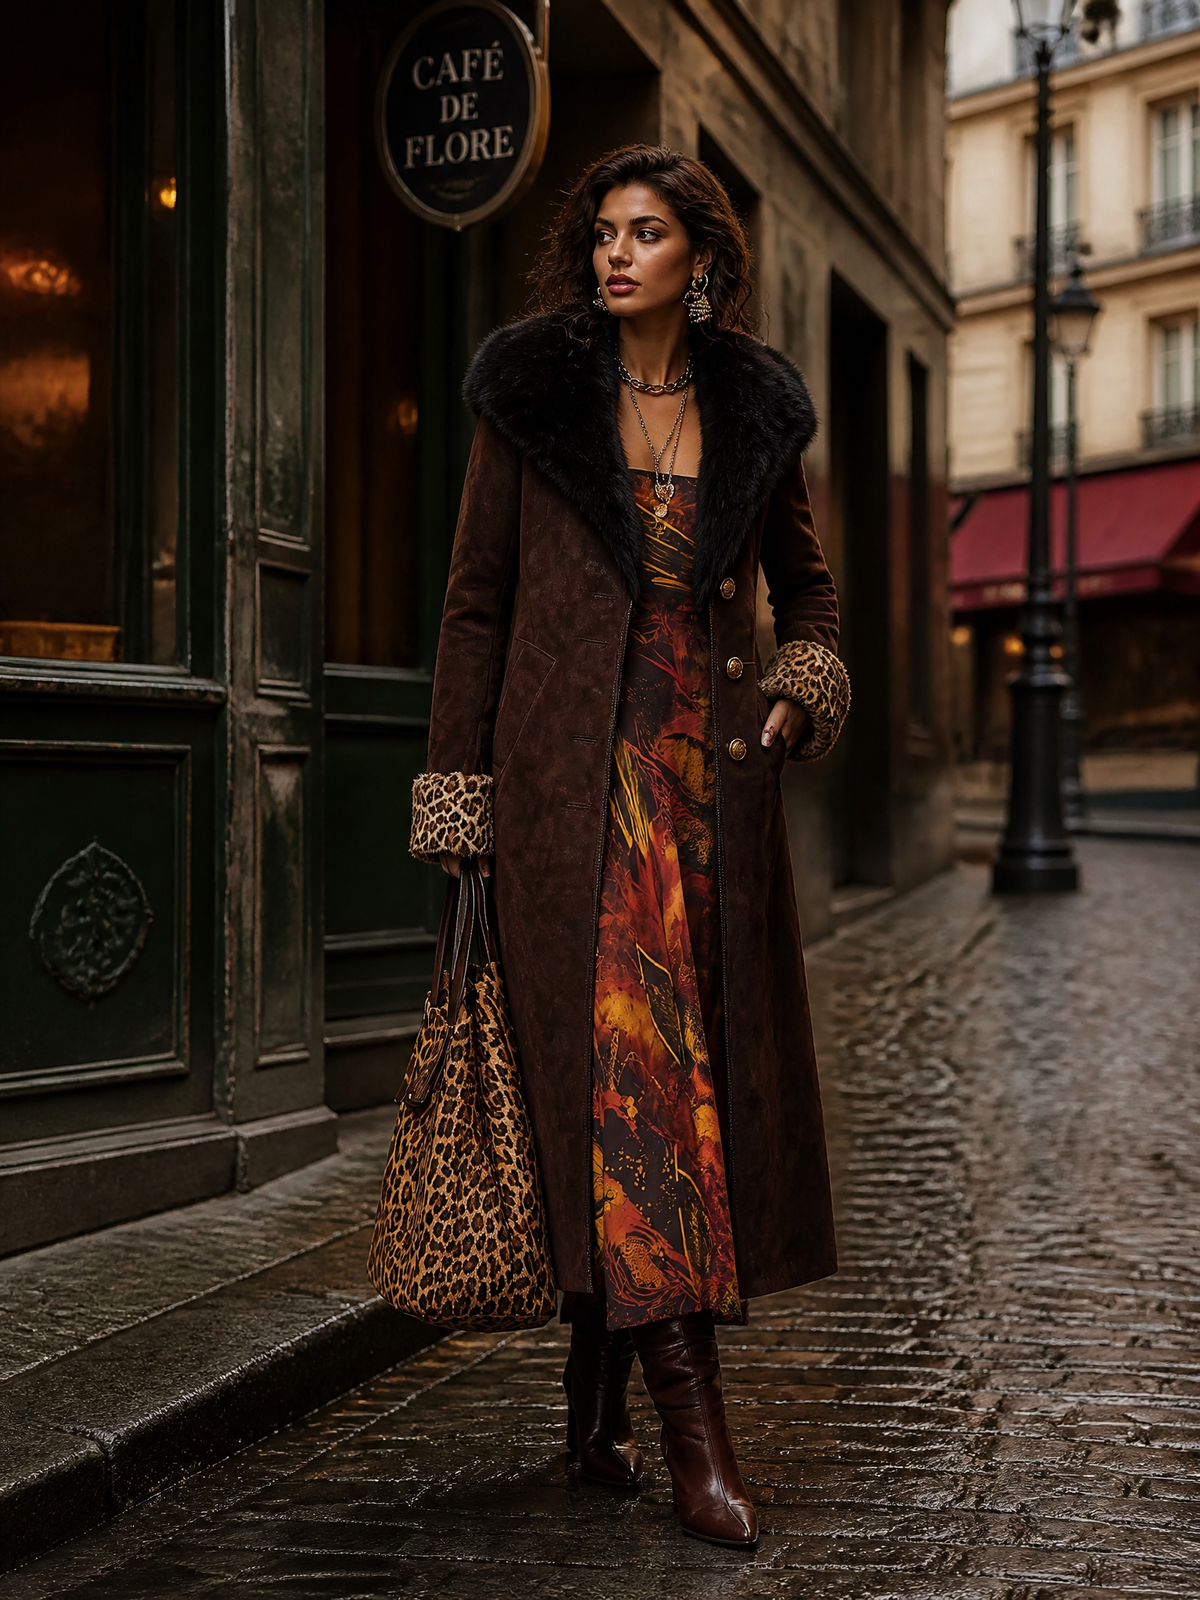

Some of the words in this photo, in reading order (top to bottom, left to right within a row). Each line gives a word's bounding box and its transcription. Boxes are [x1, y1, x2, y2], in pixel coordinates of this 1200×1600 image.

[412, 40, 504, 90] CAFÉ
[439, 91, 479, 124] DE
[403, 124, 514, 169] FLORE
